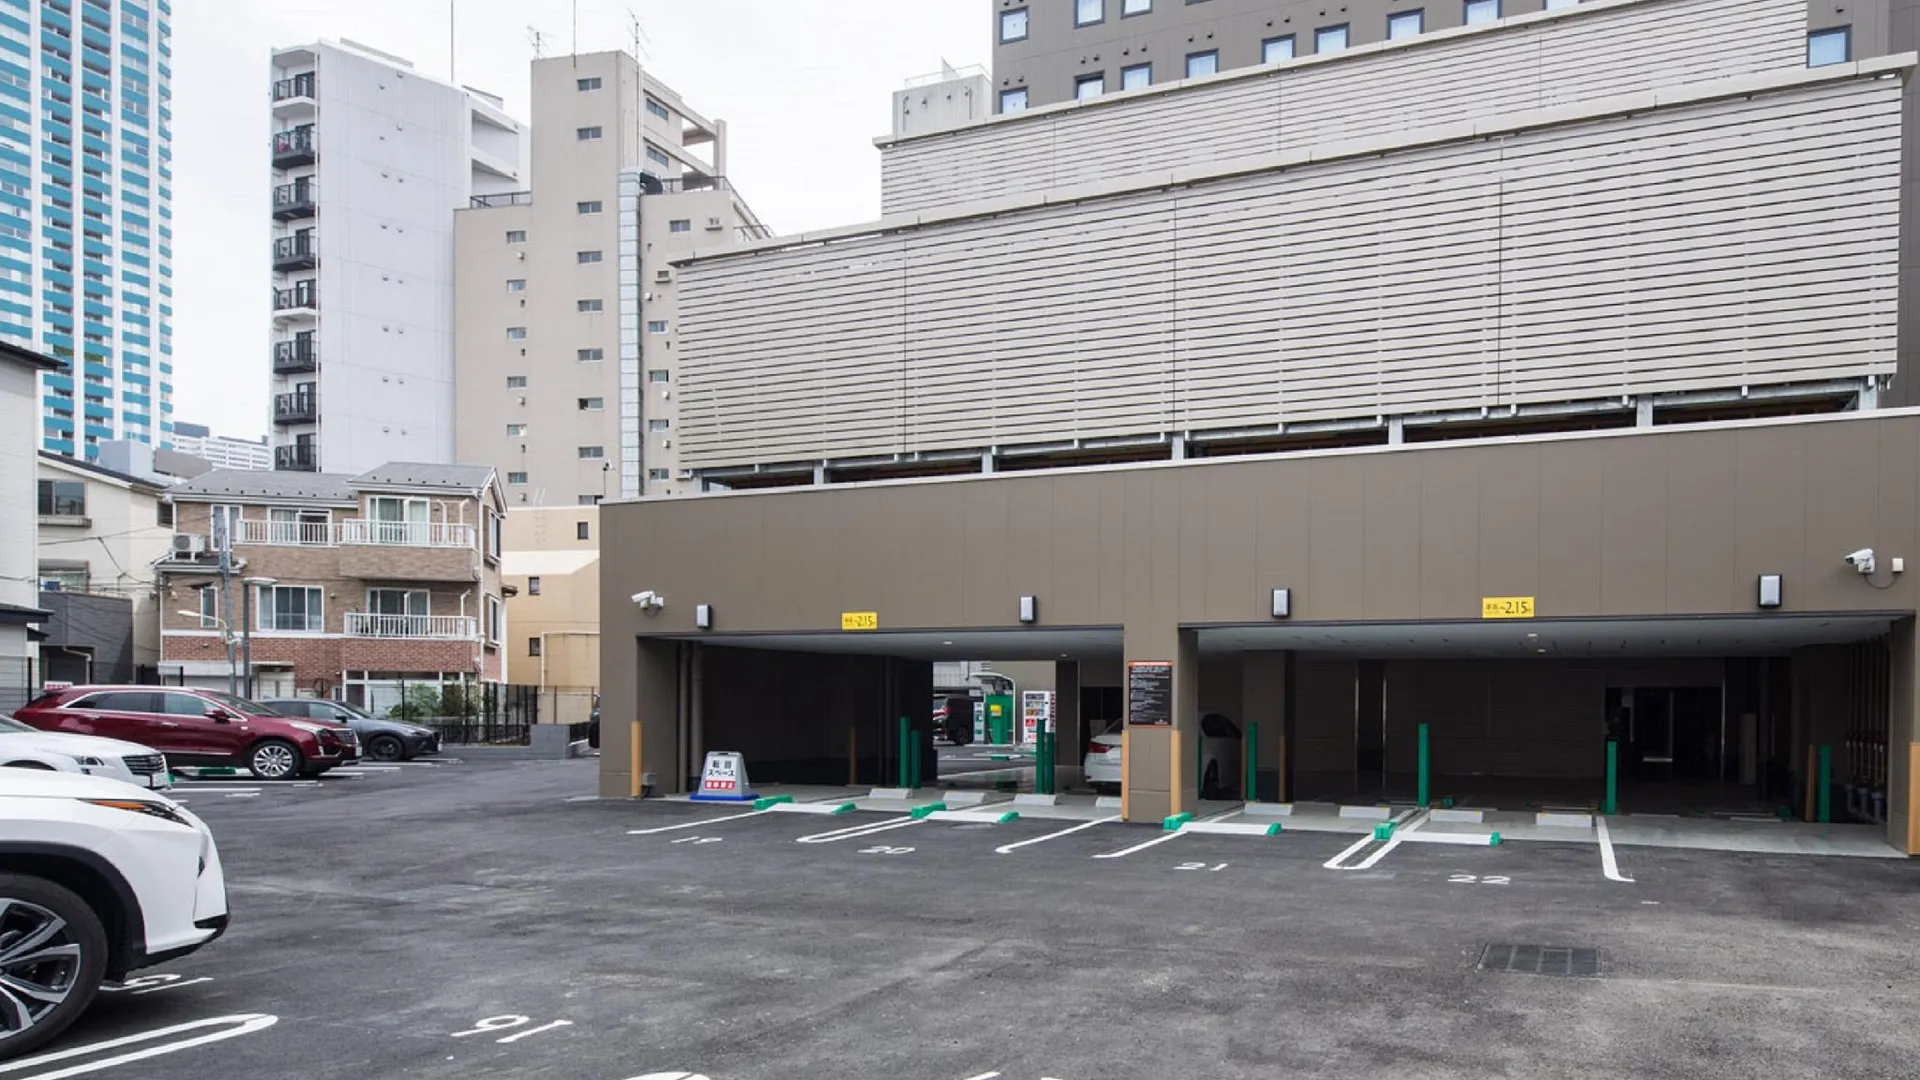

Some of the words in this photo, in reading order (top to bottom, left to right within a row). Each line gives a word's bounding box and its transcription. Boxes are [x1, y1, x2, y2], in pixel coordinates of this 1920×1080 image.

[708, 768, 735, 777] スペース
[857, 845, 915, 854] 20
[1172, 861, 1228, 871] 21
[1447, 874, 1511, 885] 22
